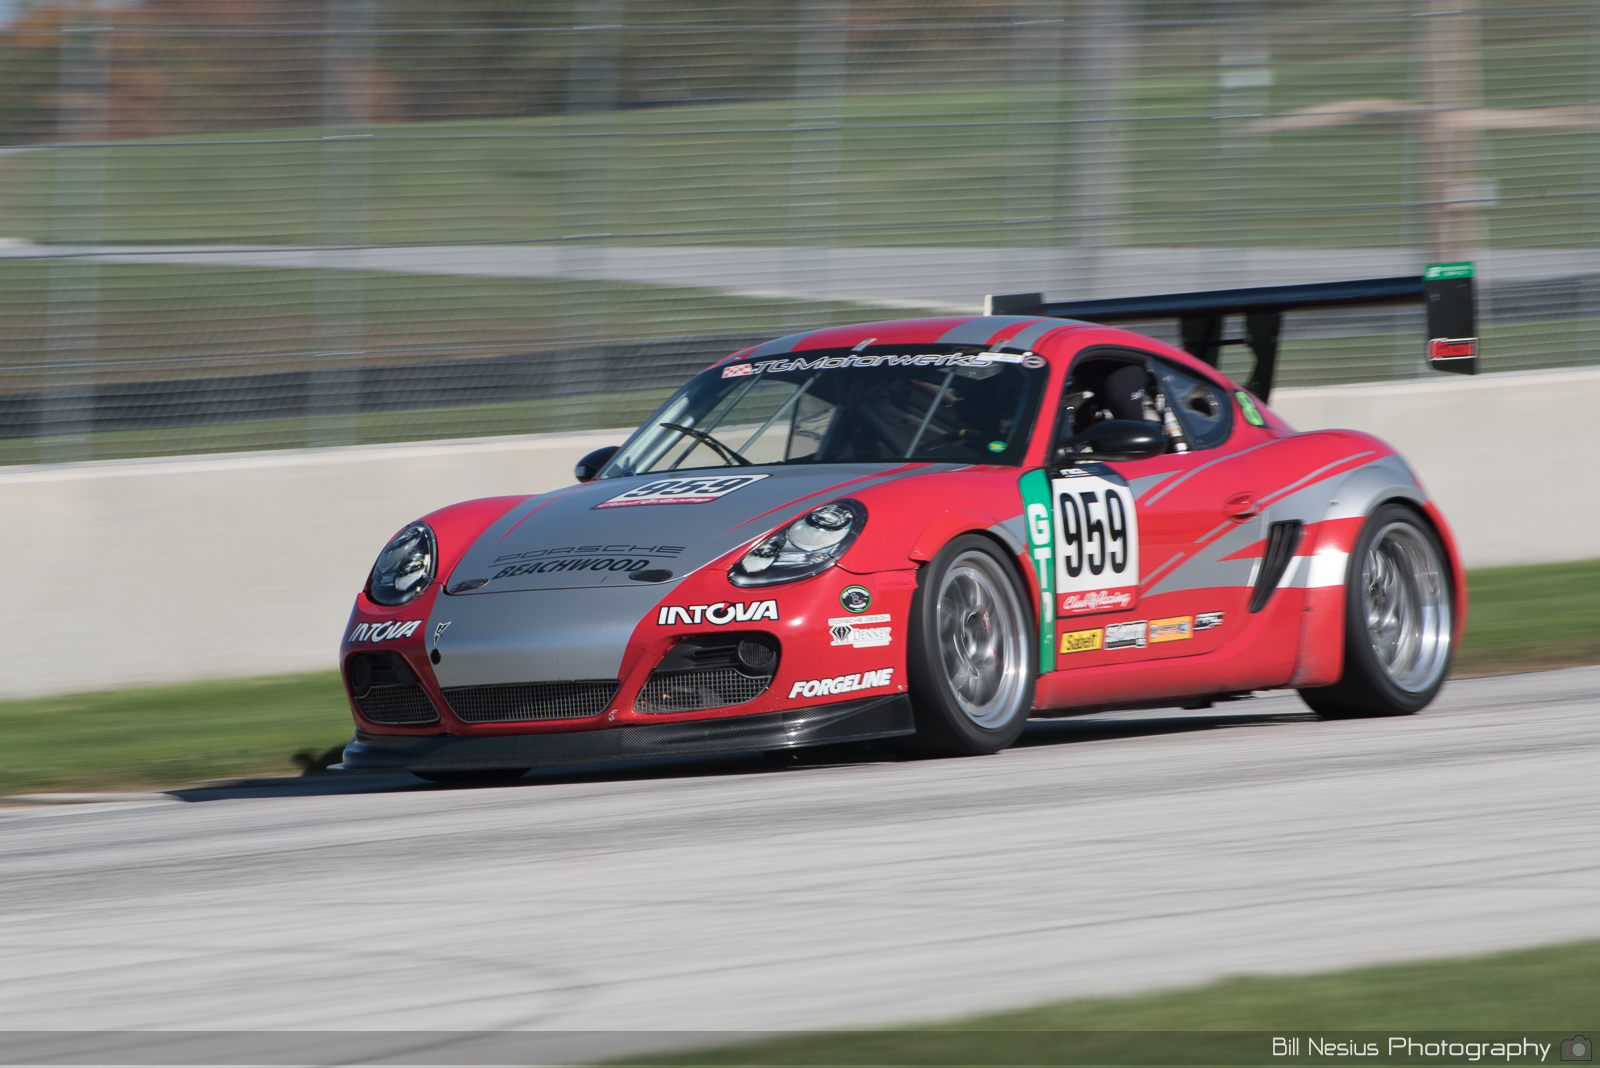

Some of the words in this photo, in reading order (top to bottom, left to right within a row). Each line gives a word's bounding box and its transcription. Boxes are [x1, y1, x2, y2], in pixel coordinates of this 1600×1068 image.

[1235, 391, 1265, 426] 8
[624, 477, 754, 498] 959
[1059, 488, 1128, 578] 959
[494, 544, 686, 564] PORSCHE
[491, 558, 651, 580] BEACHWOOD
[657, 599, 779, 625] INTOVA
[347, 619, 424, 643] INTOVA
[787, 667, 894, 699] FORGELINE
